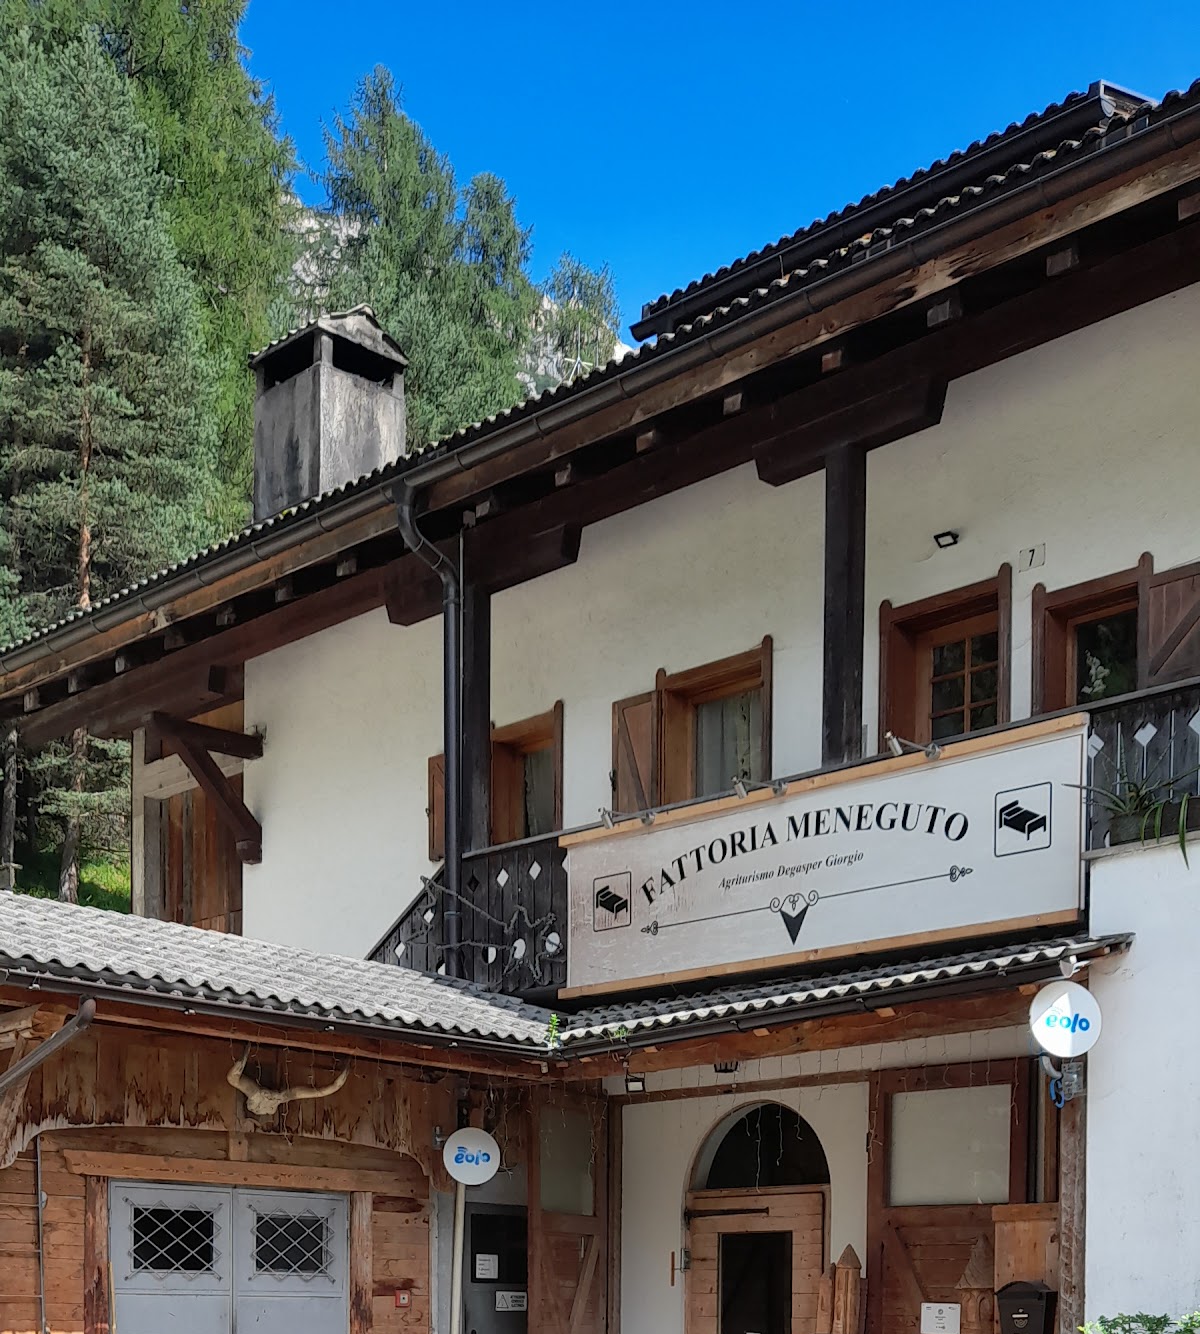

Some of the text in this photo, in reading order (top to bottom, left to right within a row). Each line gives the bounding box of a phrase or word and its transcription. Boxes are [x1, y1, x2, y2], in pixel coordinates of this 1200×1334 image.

[1029, 548, 1035, 567] 7
[640, 802, 969, 906] FATTORIA MENEGUTO
[718, 850, 864, 890] Agriturismo Degasper Giorgio
[1045, 1013, 1090, 1033] eolo
[454, 1149, 491, 1165] eolo
